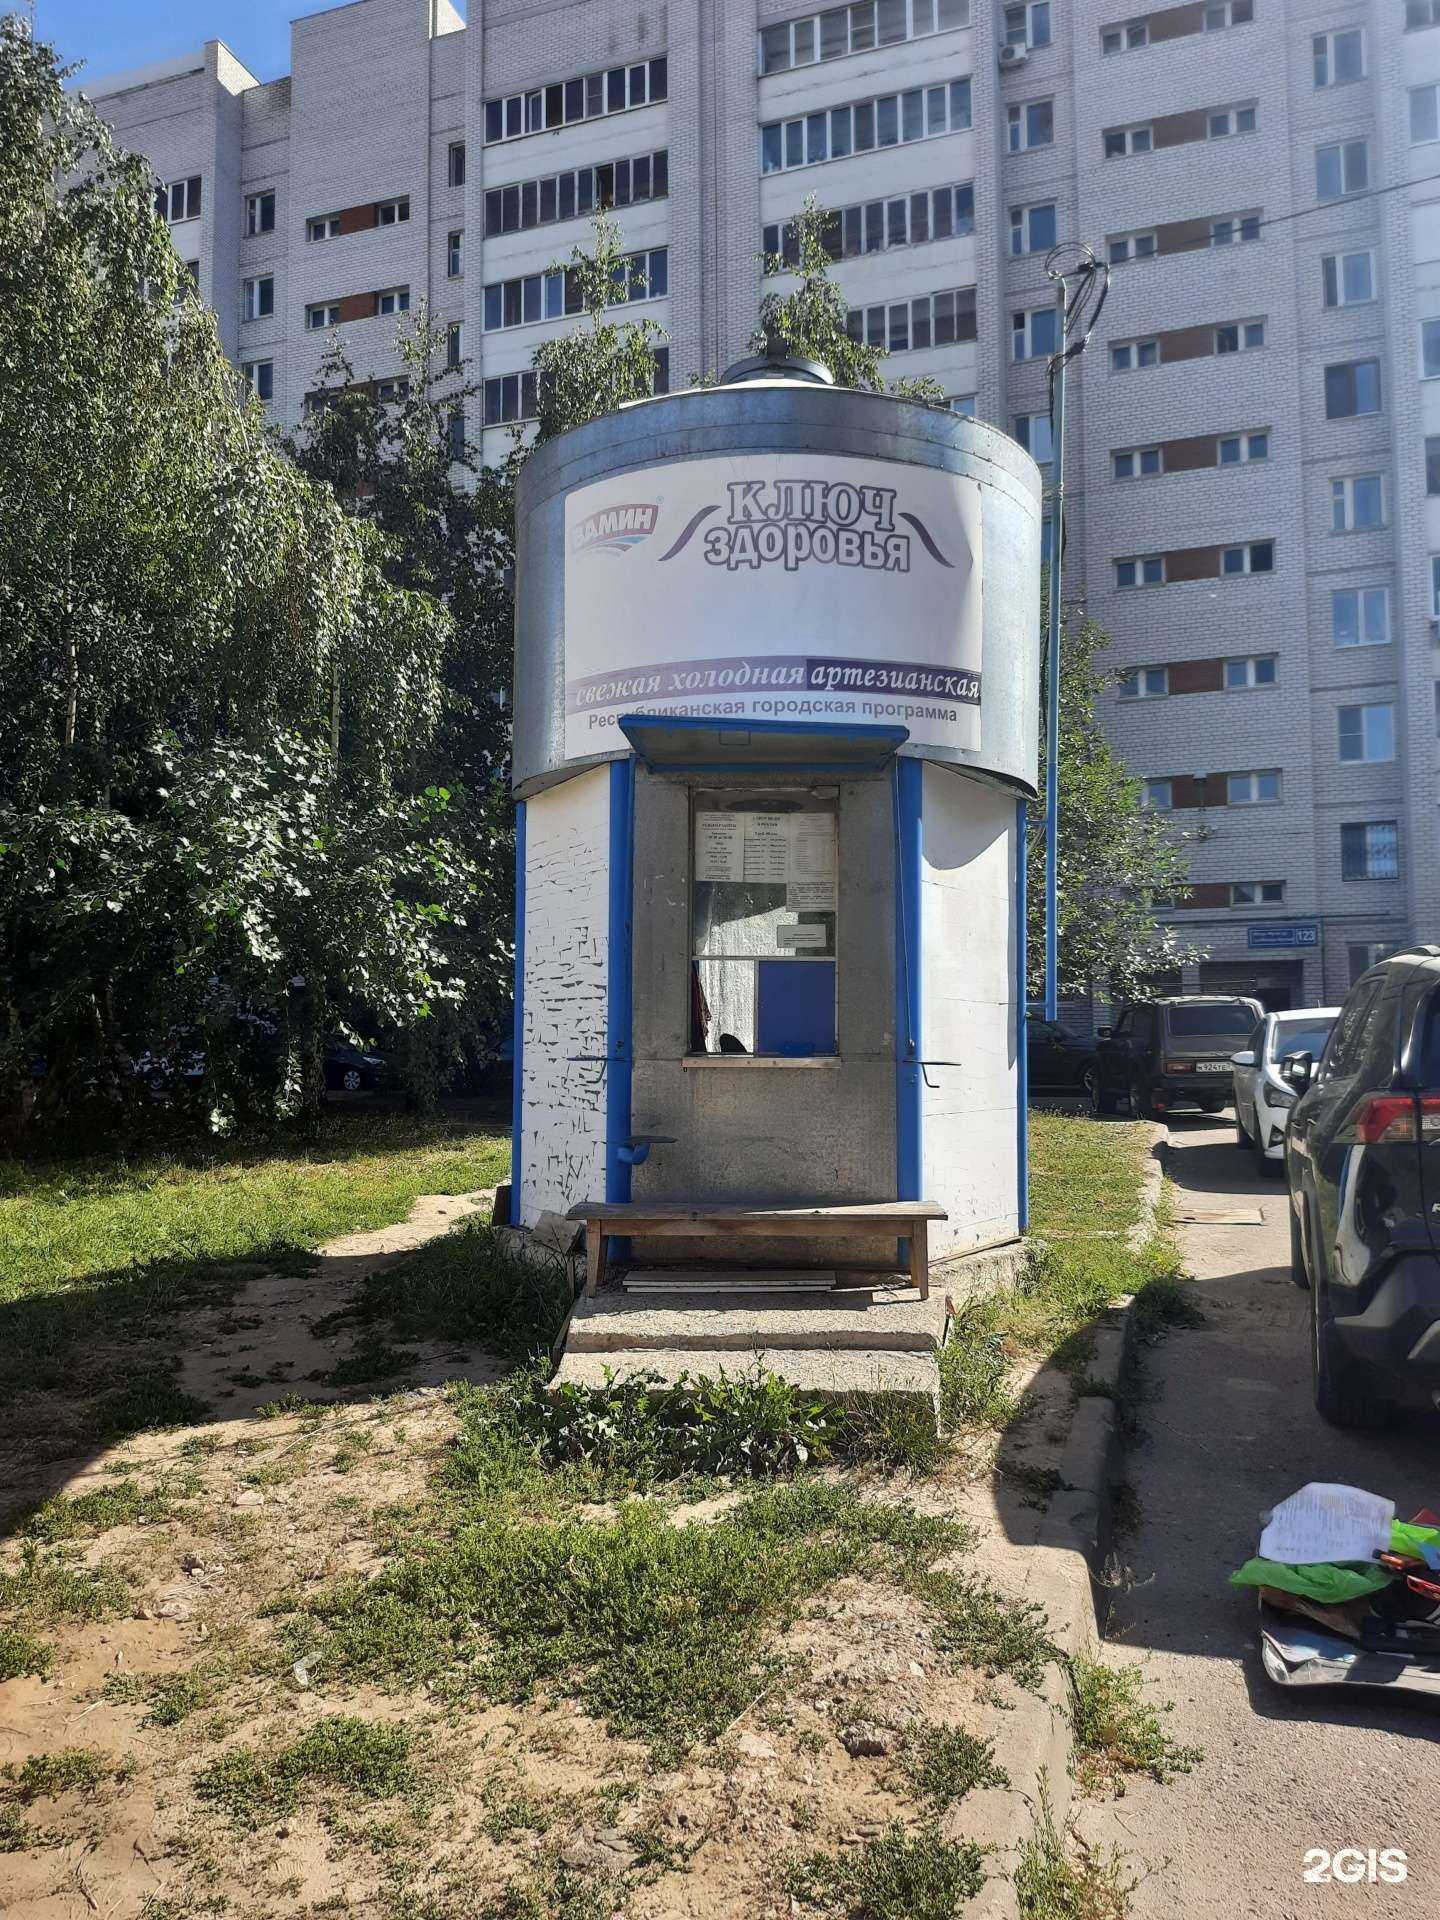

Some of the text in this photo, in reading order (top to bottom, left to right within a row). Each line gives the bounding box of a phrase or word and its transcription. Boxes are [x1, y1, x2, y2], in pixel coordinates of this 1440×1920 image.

[576, 661, 980, 706] свежая холодная артезианская
[752, 700, 856, 716] городская
[862, 702, 957, 721] программа
